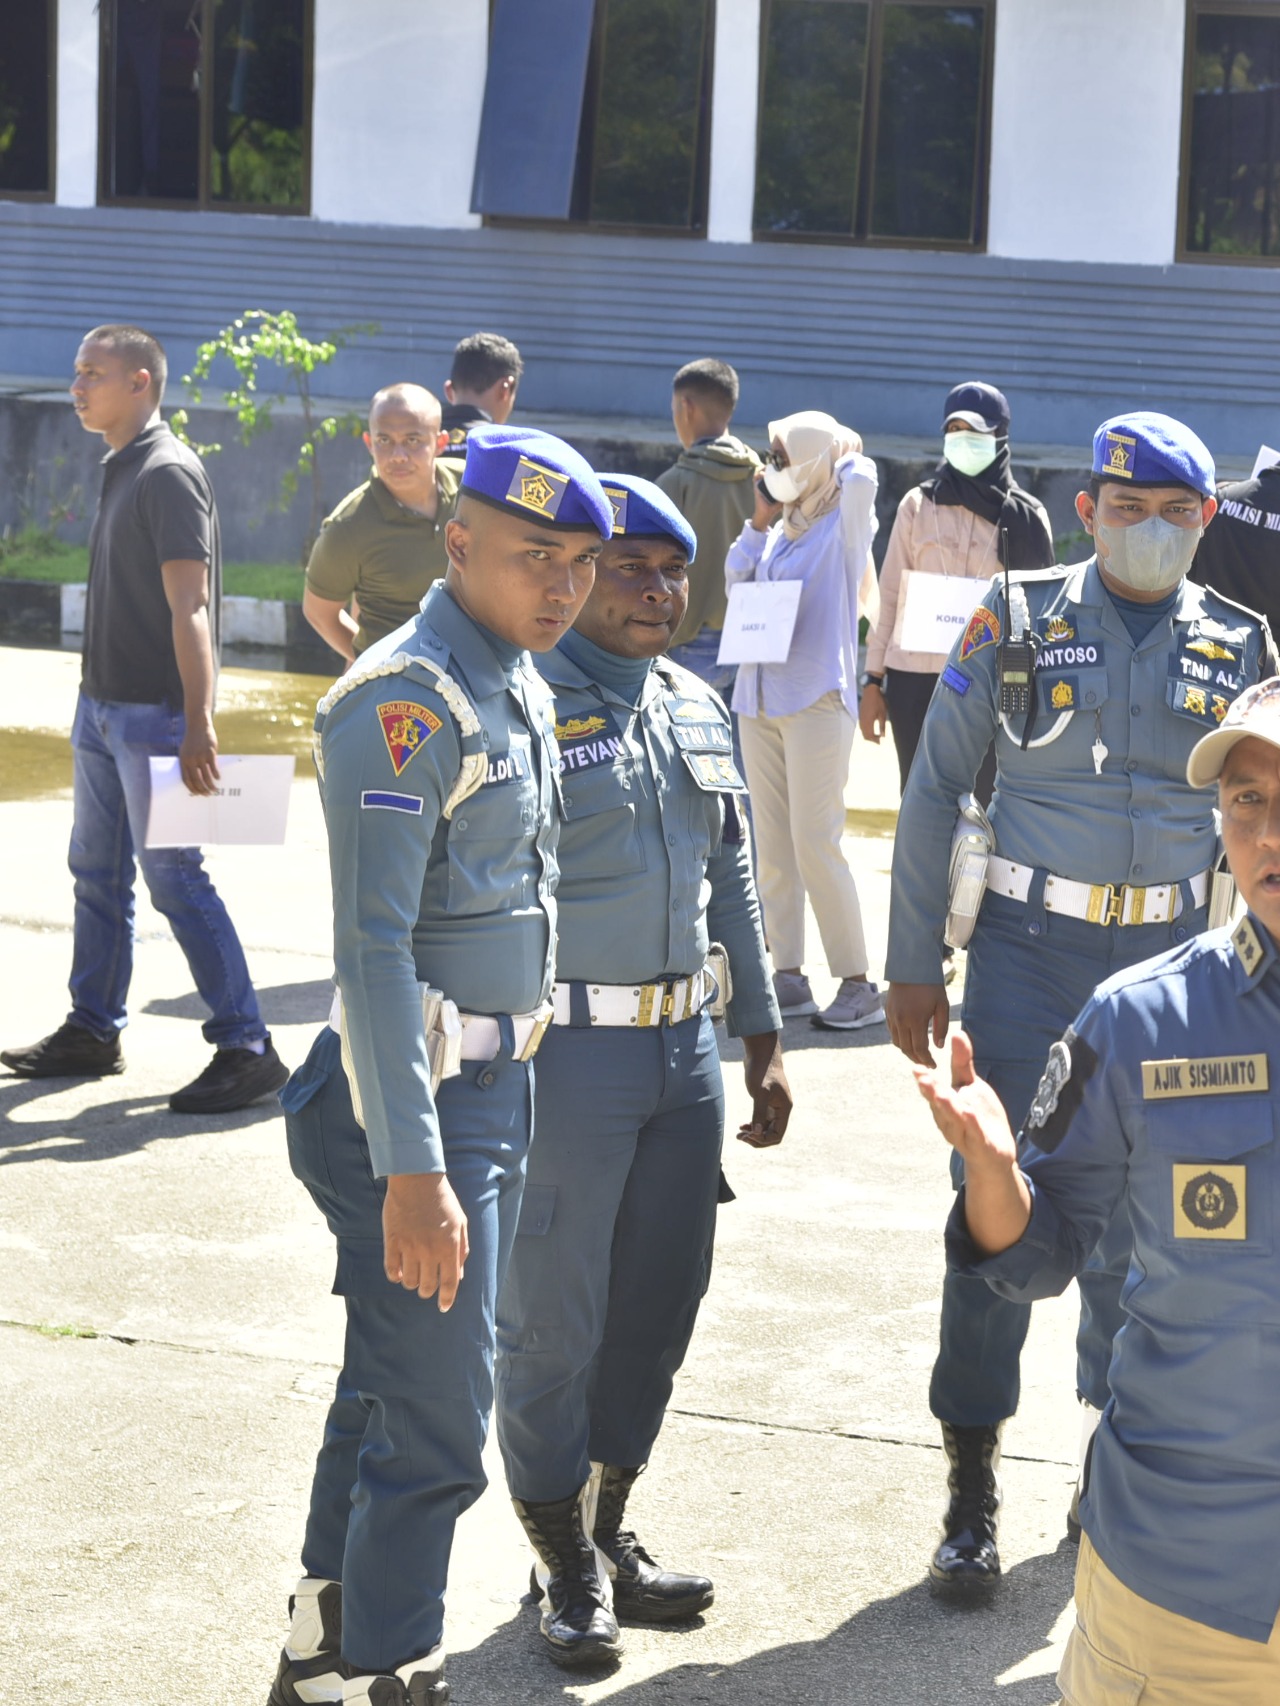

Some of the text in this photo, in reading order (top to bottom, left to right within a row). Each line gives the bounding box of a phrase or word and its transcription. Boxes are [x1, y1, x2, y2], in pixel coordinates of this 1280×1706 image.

[1219, 499, 1262, 526] POLISI
[1035, 646, 1097, 668] ANTOSO
[1180, 656, 1238, 691] TNI AL
[381, 703, 437, 728] POLISI MILITER
[675, 726, 730, 747] TNI AL
[483, 757, 513, 785] LDI
[1153, 1060, 1256, 1091] AJIK SISMIANTO
